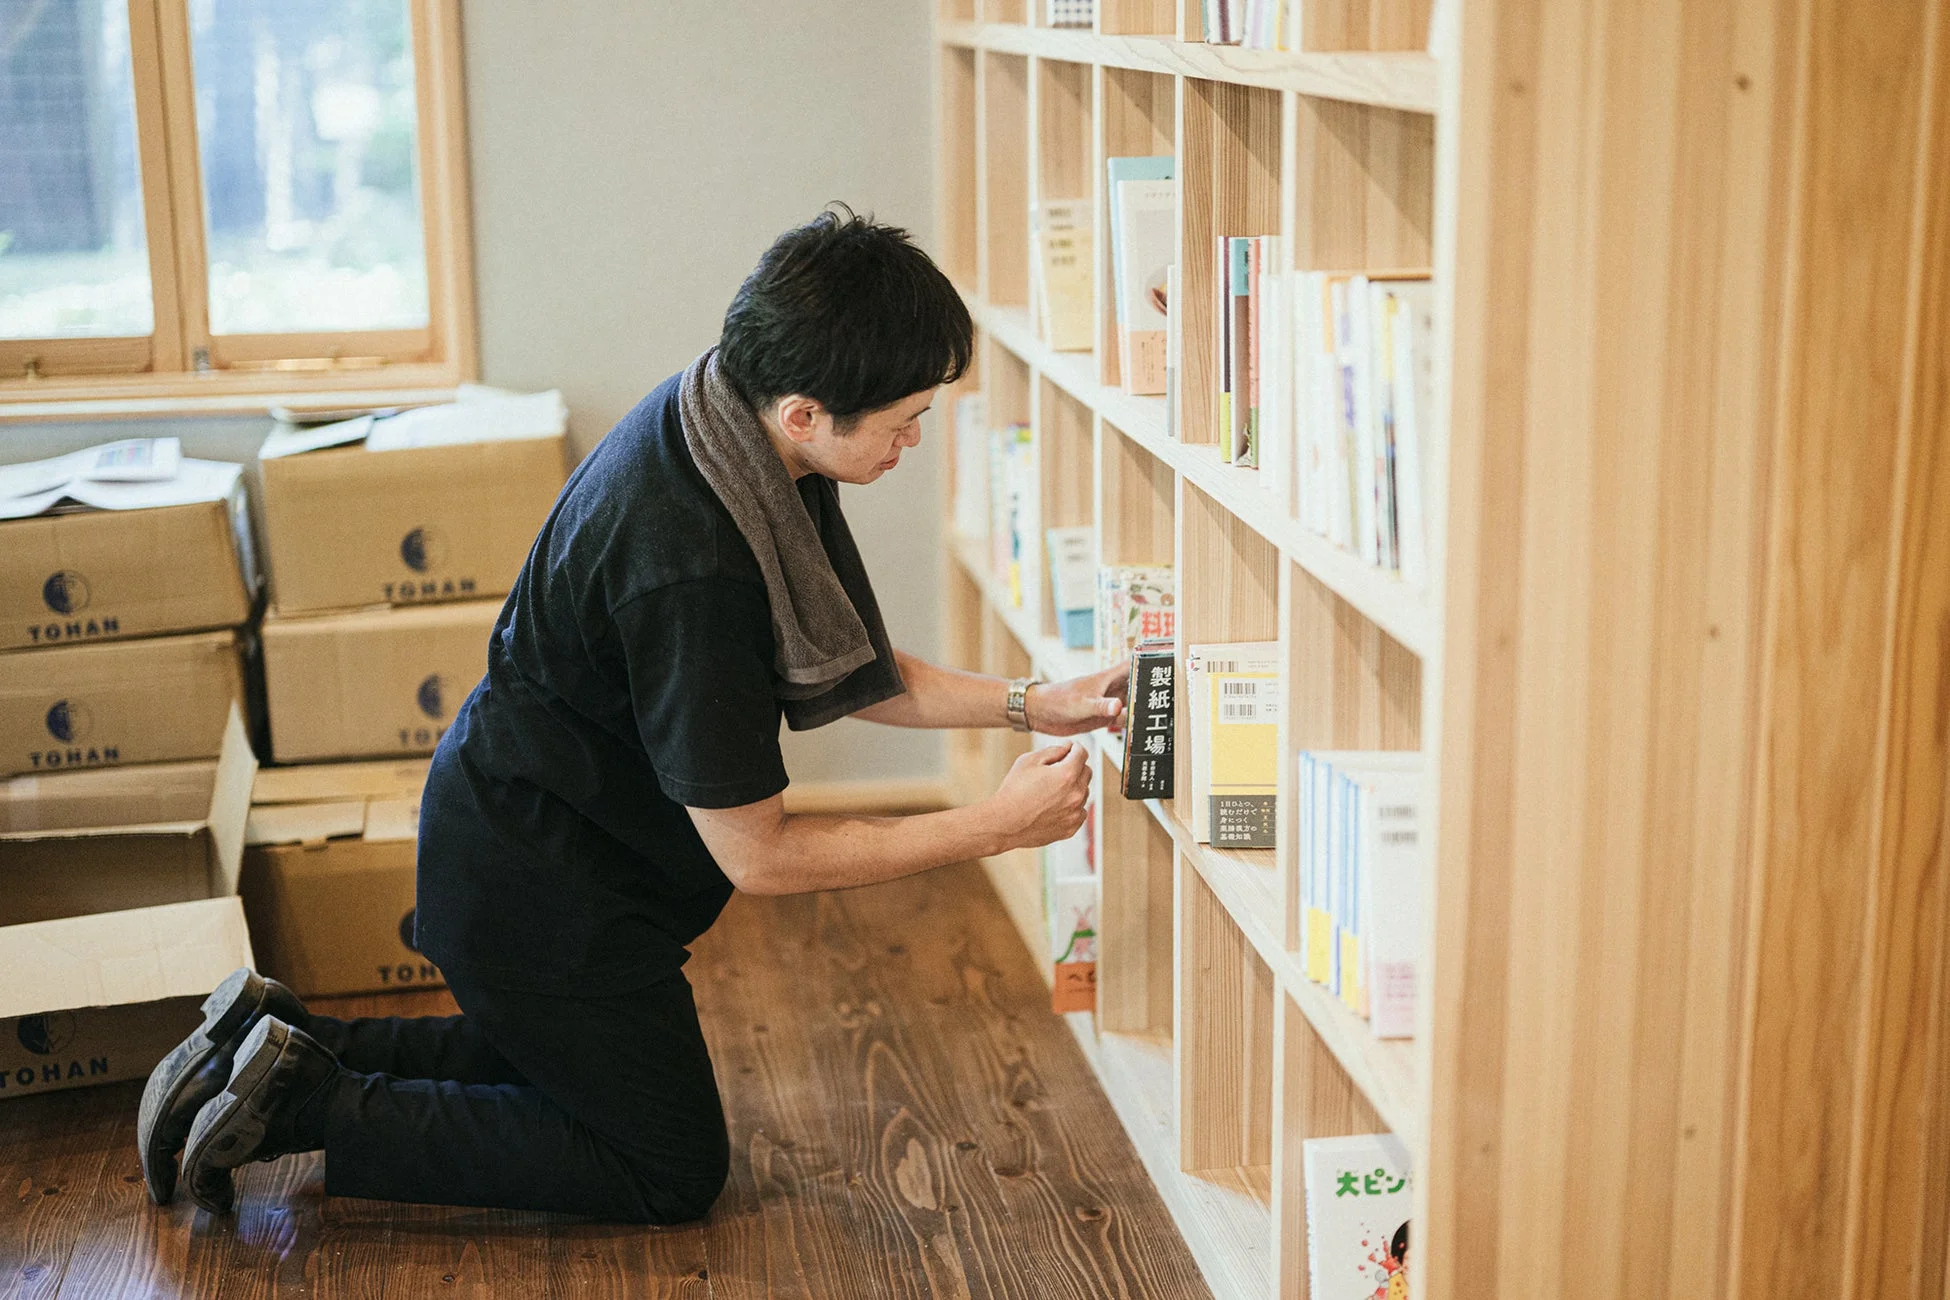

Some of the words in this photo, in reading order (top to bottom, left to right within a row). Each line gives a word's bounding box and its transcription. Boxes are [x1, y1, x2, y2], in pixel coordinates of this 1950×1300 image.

[383, 579, 476, 599] TOHAN
[28, 616, 119, 641] TOHAN
[1144, 665, 1172, 755] 製紙工場
[29, 748, 119, 768] TOHAN
[0, 1057, 108, 1089] TOHAN
[1336, 1168, 1406, 1198] 大ピン
